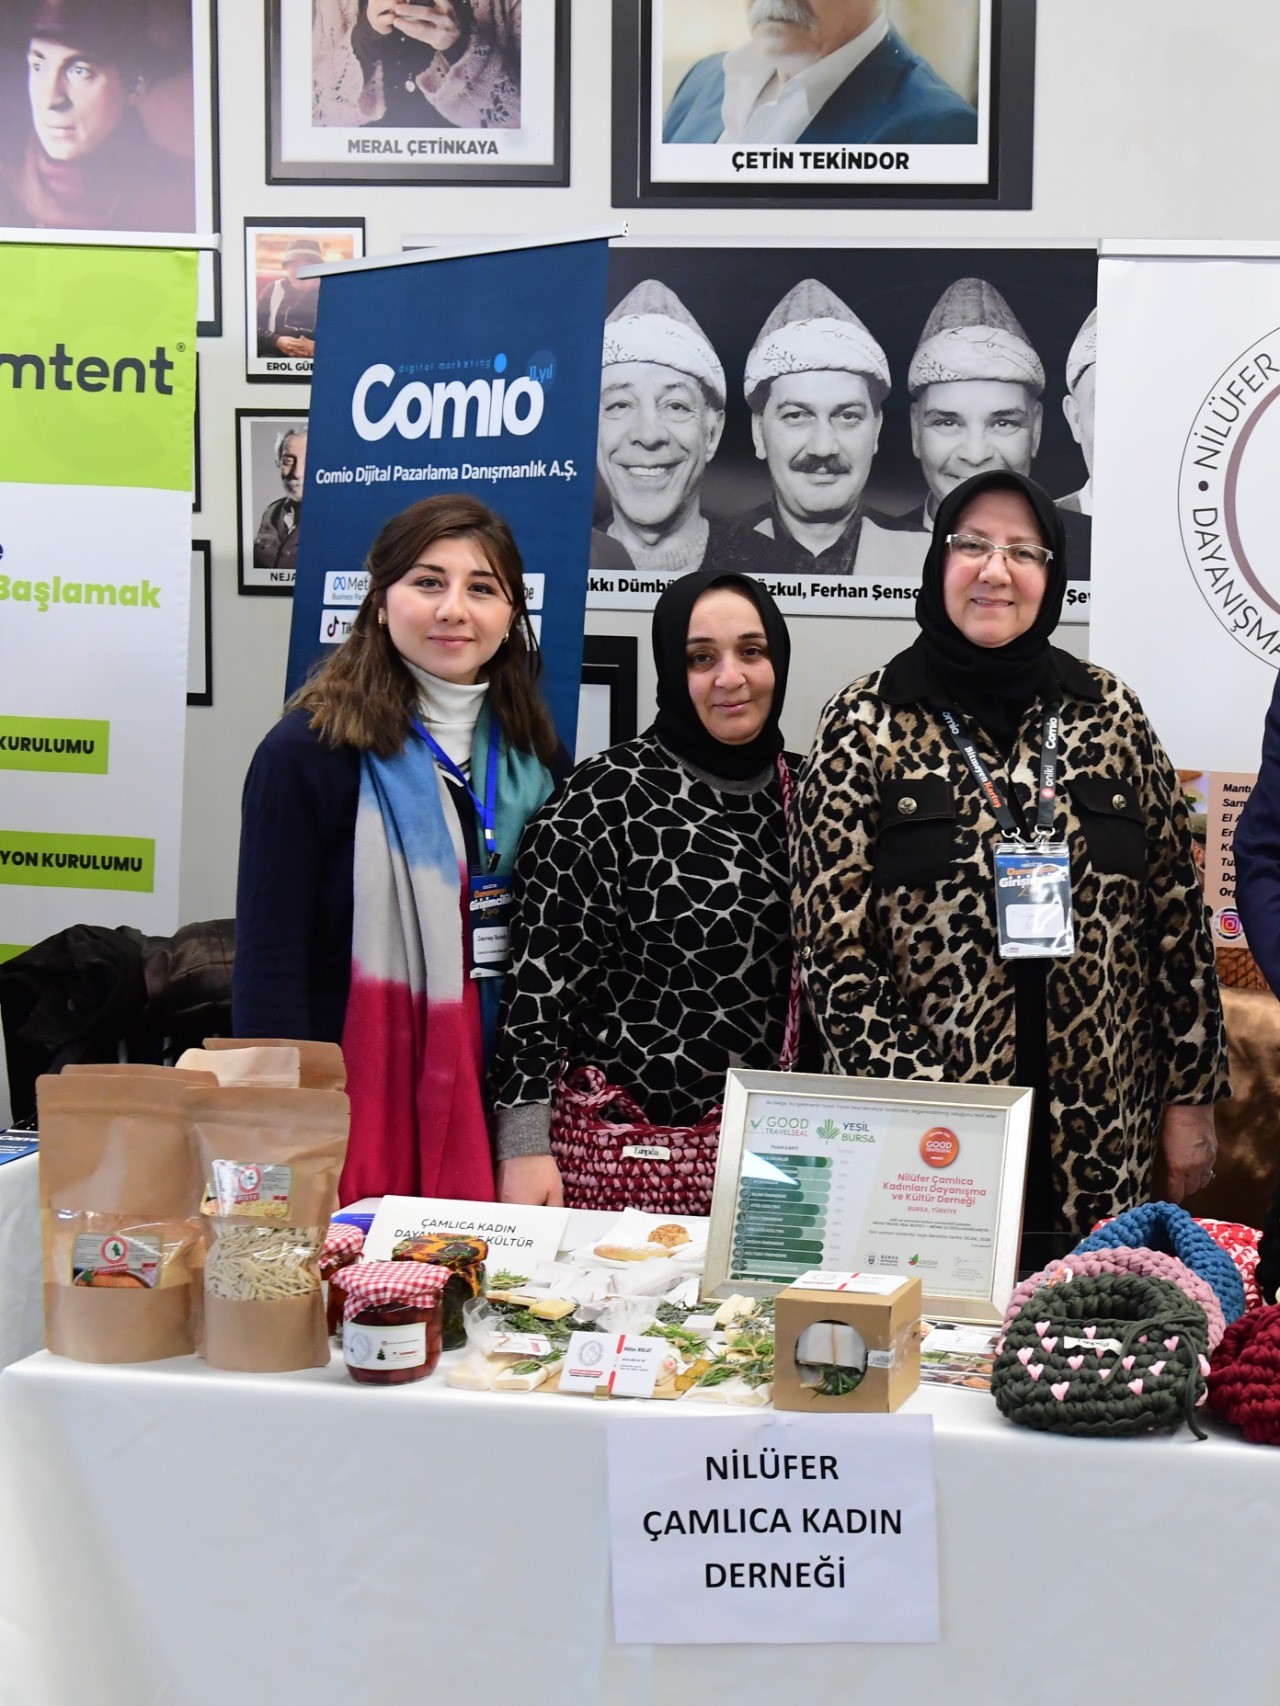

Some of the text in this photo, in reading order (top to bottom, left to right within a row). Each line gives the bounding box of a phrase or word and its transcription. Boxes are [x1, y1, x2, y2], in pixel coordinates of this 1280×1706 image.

[348, 137, 499, 156] MERAL ÇETİNKAYA
[732, 148, 910, 172] ÇETİN TEKİNDOR
[266, 362, 293, 371] EROL
[399, 358, 491, 375] digital marketing
[351, 353, 545, 441] Comio
[1193, 353, 1280, 470] NİLÜFER
[315, 460, 578, 486] Comio Dijital Pazarlama Danışmanlık A.Ş.
[347, 576, 369, 591] Met
[811, 583, 868, 599] Ferhan
[872, 584, 921, 602] Şenso
[942, 711, 960, 735] omio
[1045, 717, 1058, 749] Comio
[1221, 813, 1233, 823] El
[42, 853, 143, 872] KURULUMU
[767, 1117, 870, 1133] GOOD YEŞİL
[841, 1133, 876, 1143] BURSA
[926, 1141, 952, 1149] GOOD
[897, 1173, 974, 1186] Nilüfer Çamlıca
[882, 1182, 987, 1197] Kadınları Dayanışma
[905, 1193, 936, 1203] Kültür
[937, 1195, 976, 1207] Derneği
[421, 1218, 517, 1234] ÇAMLICA KADIN
[486, 1234, 534, 1248] KÜLTÜR
[705, 1448, 839, 1480] NİLÜFER
[642, 1508, 902, 1541] ÇAMLICA KADIN
[705, 1555, 845, 1588] DERNEĞİ
